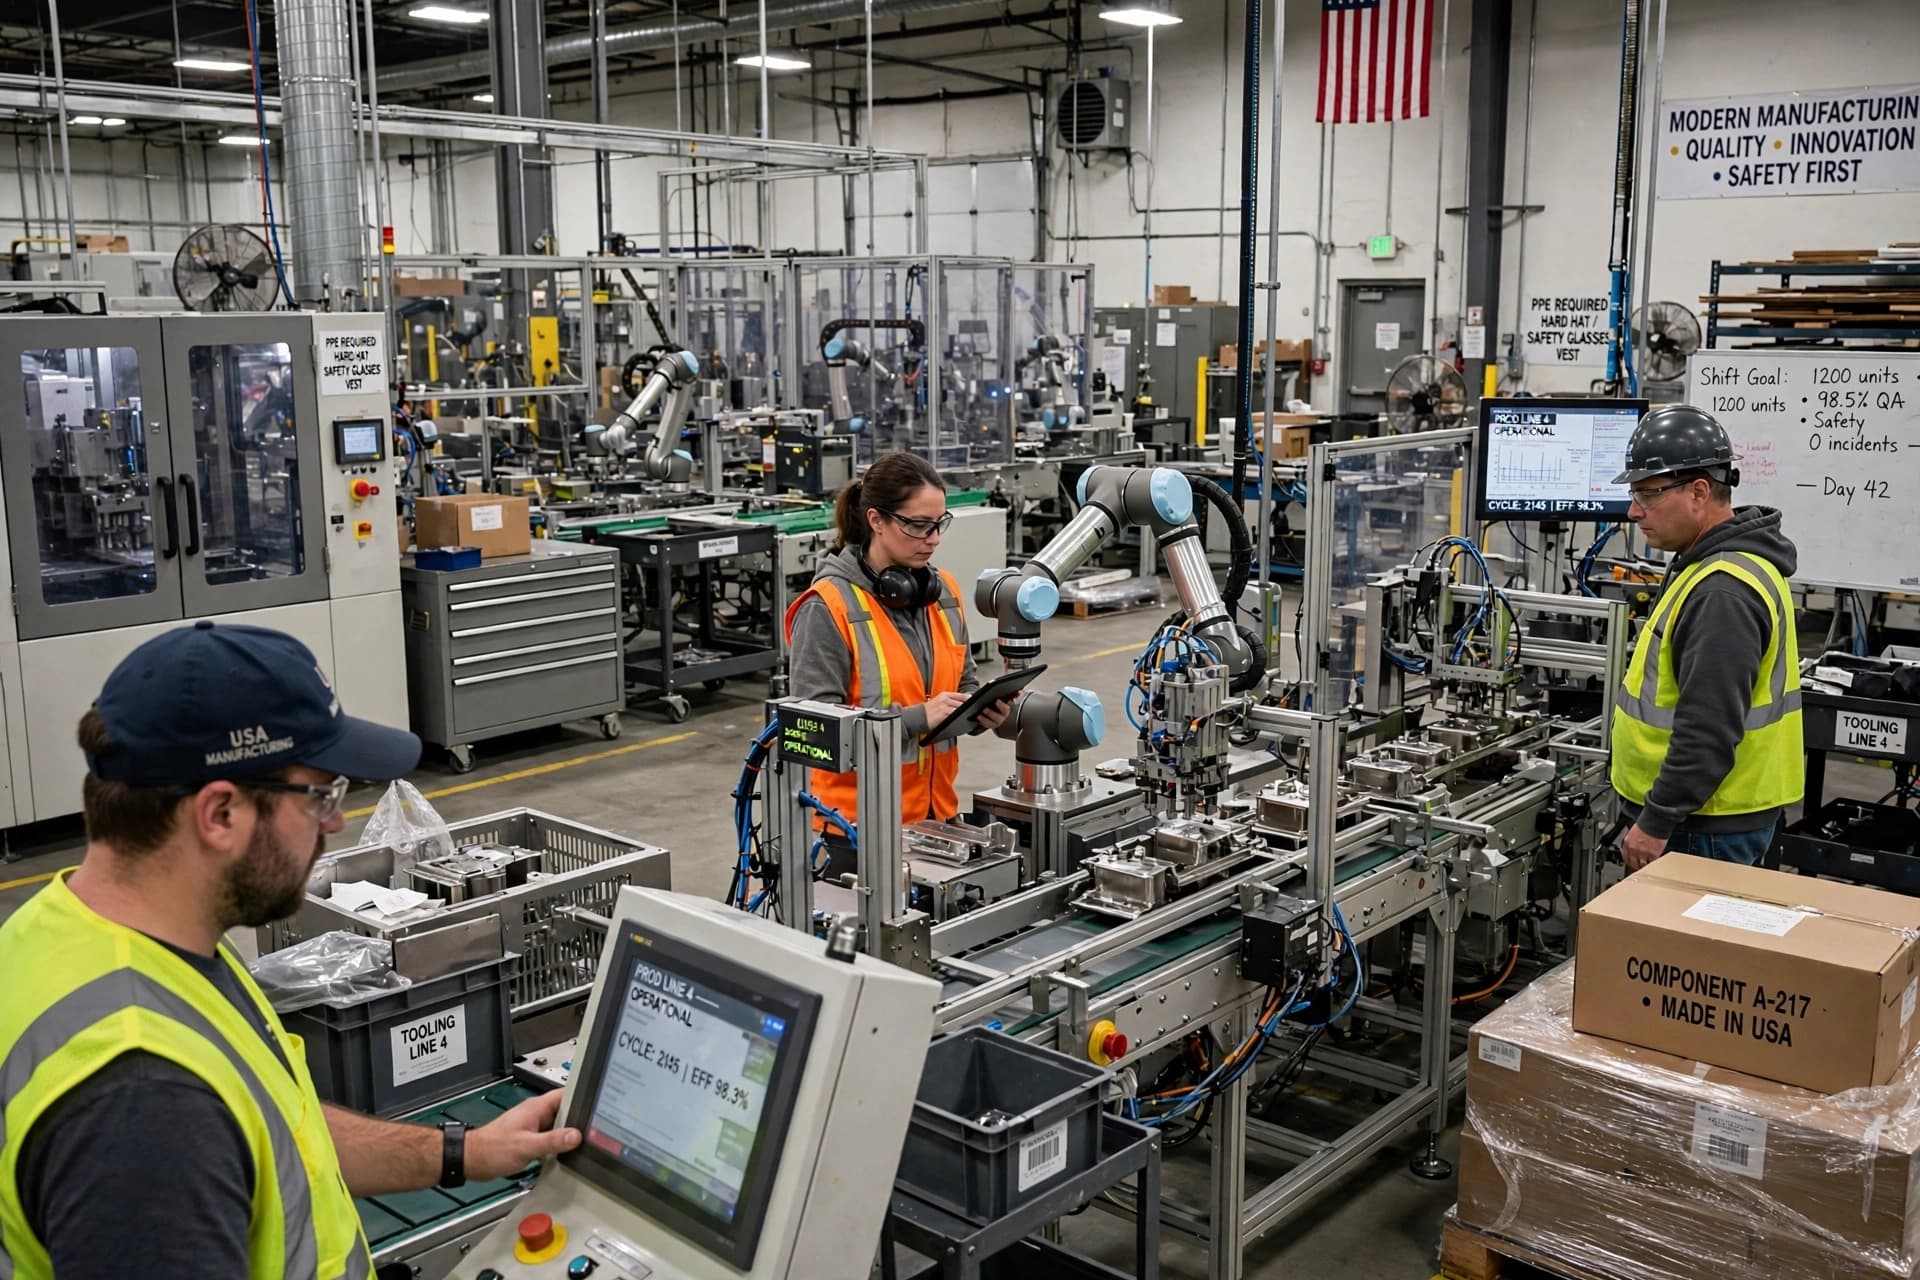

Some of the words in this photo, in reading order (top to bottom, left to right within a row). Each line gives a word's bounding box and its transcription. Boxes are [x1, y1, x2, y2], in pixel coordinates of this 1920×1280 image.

[1669, 106, 1751, 133] MODERN
[1757, 95, 1919, 128] MANUFACTURIN
[1686, 135, 1766, 162] QUALITY
[1790, 126, 1915, 155] INNOVATION
[1728, 162, 1799, 187] SAFETY
[1806, 159, 1862, 183] FIRST
[1531, 298, 1551, 311] PPE
[1555, 298, 1608, 312] REQUIRED
[1541, 315, 1568, 328] HARD
[1570, 315, 1590, 328] HAT
[1527, 331, 1565, 345] SAFETY
[1556, 348, 1580, 361] VEST
[345, 378, 362, 390] VEST
[1700, 366, 1740, 386] Shift
[1747, 367, 1788, 386] Goal:
[1813, 367, 1851, 384] 1200
[1859, 366, 1900, 384] units
[1713, 396, 1745, 412] 1200
[1751, 395, 1787, 412] units
[1817, 391, 1869, 408] 98.5%
[1876, 391, 1905, 409] QA
[1814, 411, 1865, 436] Safety
[1809, 433, 1821, 450] 0
[1828, 435, 1898, 453] incidents
[1823, 476, 1856, 506] Day
[1863, 479, 1891, 499] 42
[1488, 501, 1521, 511] CYCLE:
[1556, 501, 1575, 511] EFF
[229, 724, 270, 748] USA
[1843, 716, 1899, 734] TOOLING
[205, 736, 295, 766] MANUFACTURING
[1848, 732, 1877, 748] LINE
[1880, 736, 1888, 749] 4
[634, 963, 662, 987] PROD
[662, 975, 687, 998] LINE
[686, 985, 694, 1000] 4
[1626, 956, 1747, 1004] COMPONENT
[1753, 985, 1811, 1019] A-217
[401, 1014, 456, 1044] TOOLING
[1661, 995, 1717, 1029] MADE
[1724, 1009, 1744, 1036] IN
[1751, 1015, 1793, 1048] USA
[410, 1038, 438, 1060] LINE
[440, 1035, 448, 1049] 4
[618, 1031, 656, 1062] CYCLE:
[690, 1066, 714, 1090] EFF
[713, 1078, 751, 1111] 98.3%
